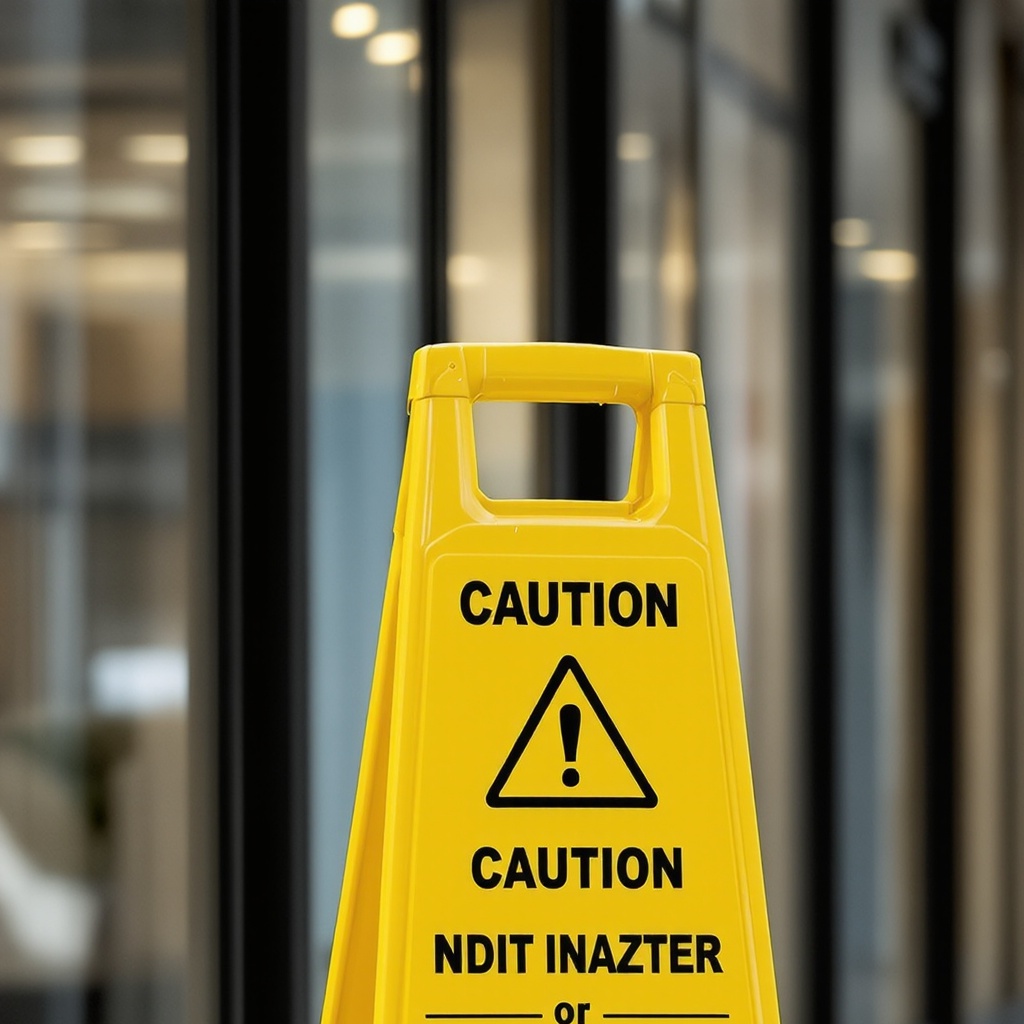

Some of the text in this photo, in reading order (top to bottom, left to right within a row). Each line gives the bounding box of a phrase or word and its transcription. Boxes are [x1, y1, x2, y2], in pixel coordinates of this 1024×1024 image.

[460, 580, 678, 628] CAUTION
[471, 846, 683, 890] CAUTION
[434, 934, 724, 974] NDIT INAZTER
